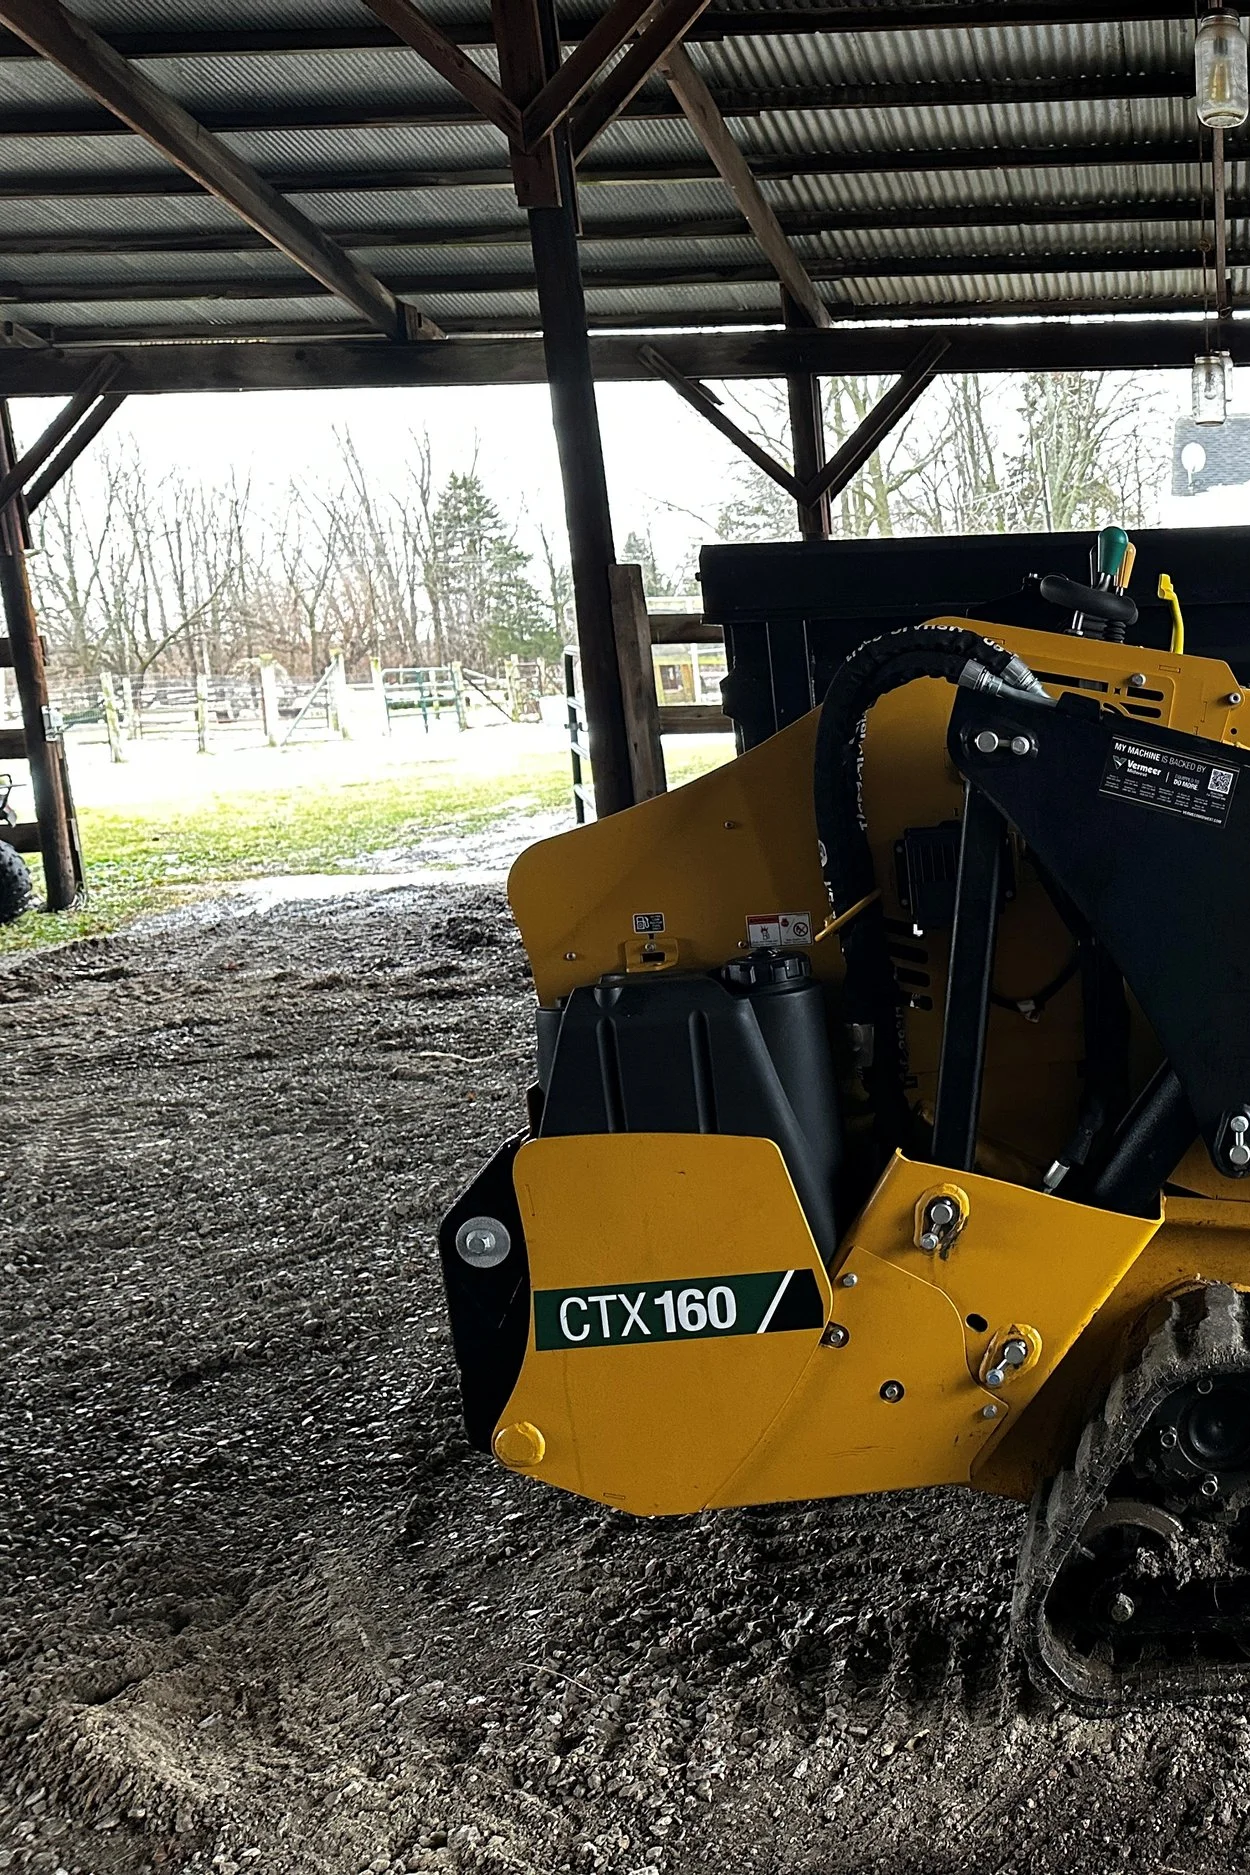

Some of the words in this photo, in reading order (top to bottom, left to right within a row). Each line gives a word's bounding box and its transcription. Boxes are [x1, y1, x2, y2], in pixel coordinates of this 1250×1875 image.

[1114, 742, 1127, 752] MY
[1127, 746, 1161, 762] MACHINE
[1161, 755, 1169, 764] IS
[1169, 757, 1196, 771] BACKED
[1196, 764, 1207, 773] BY
[1127, 759, 1161, 776] Vermeer
[1173, 778, 1182, 786] DO
